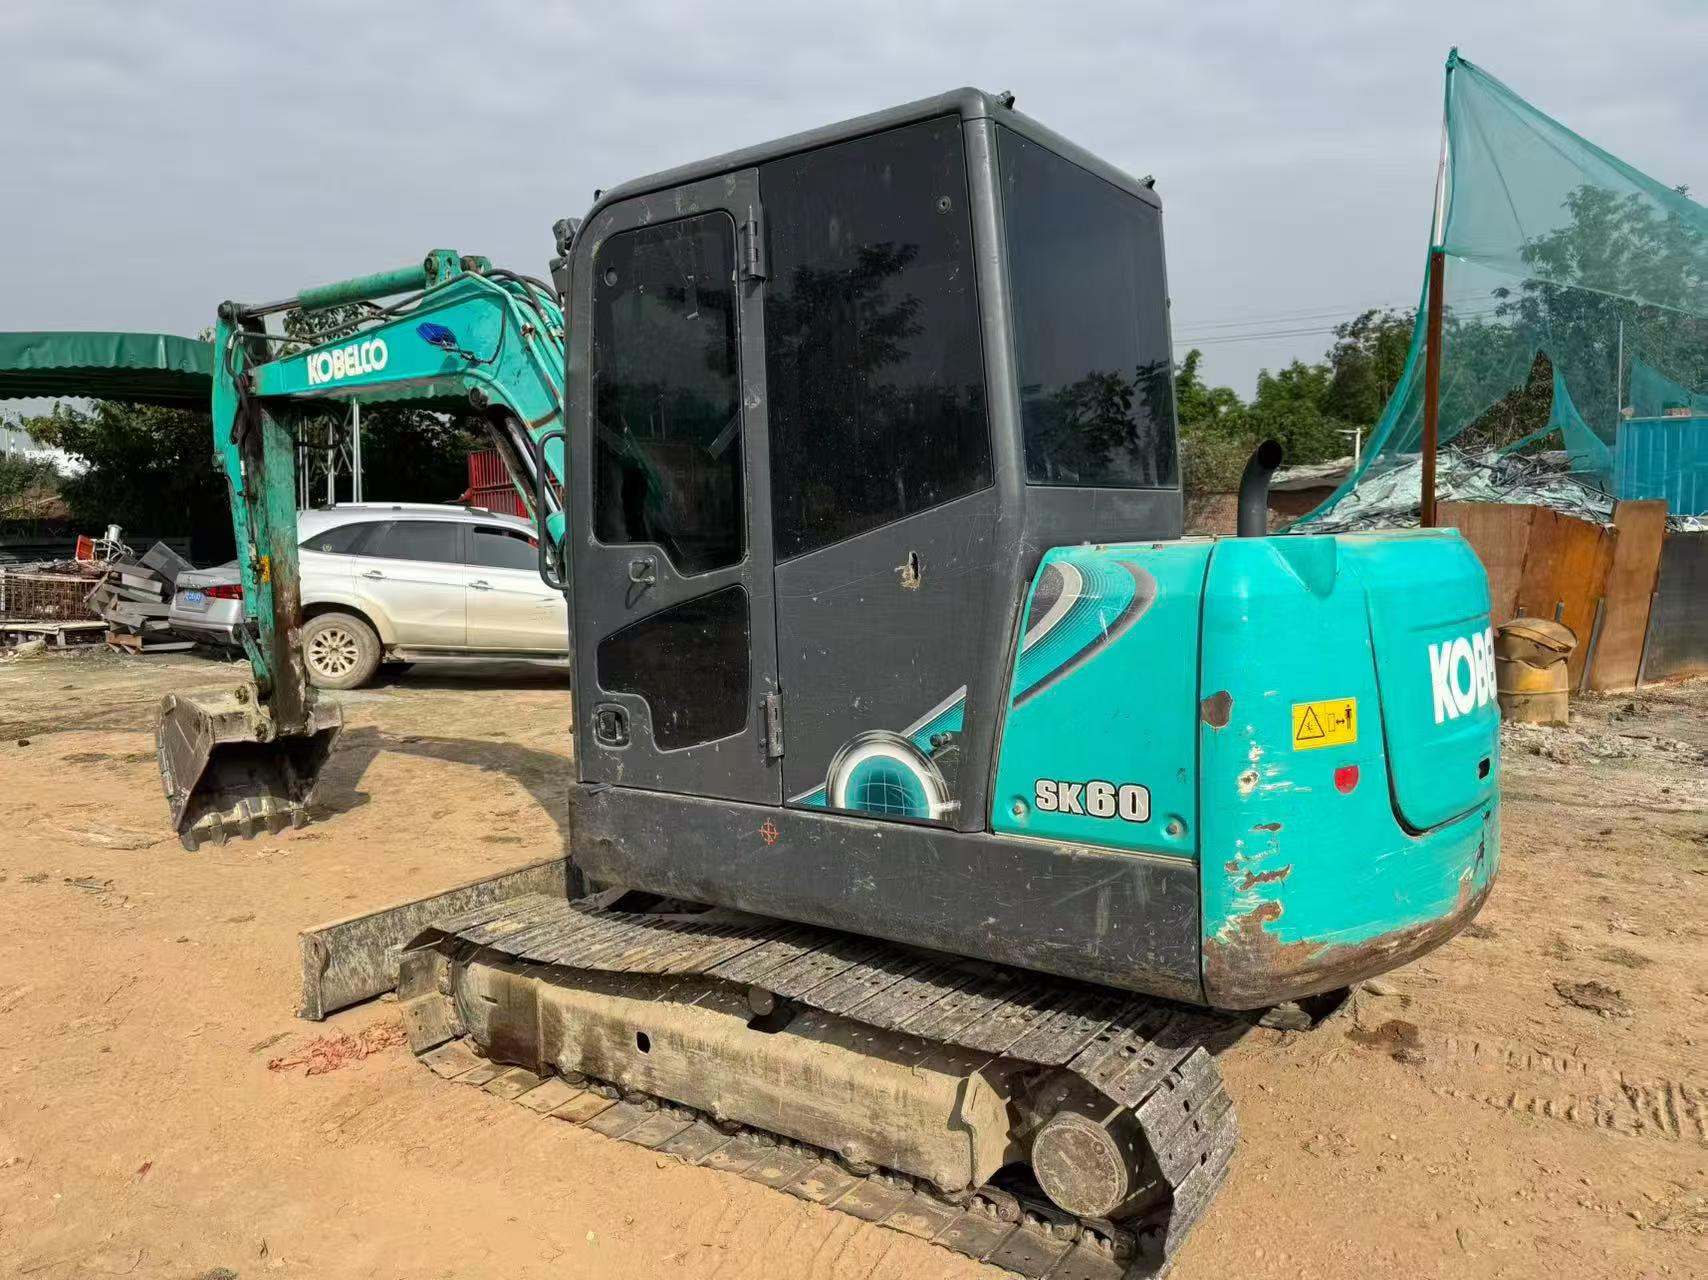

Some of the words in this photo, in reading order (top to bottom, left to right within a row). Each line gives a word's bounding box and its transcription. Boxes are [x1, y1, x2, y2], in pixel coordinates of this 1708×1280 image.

[307, 338, 388, 385] KOBELCO
[1428, 626, 1497, 724] KOBE
[1035, 778, 1151, 823] SK60
